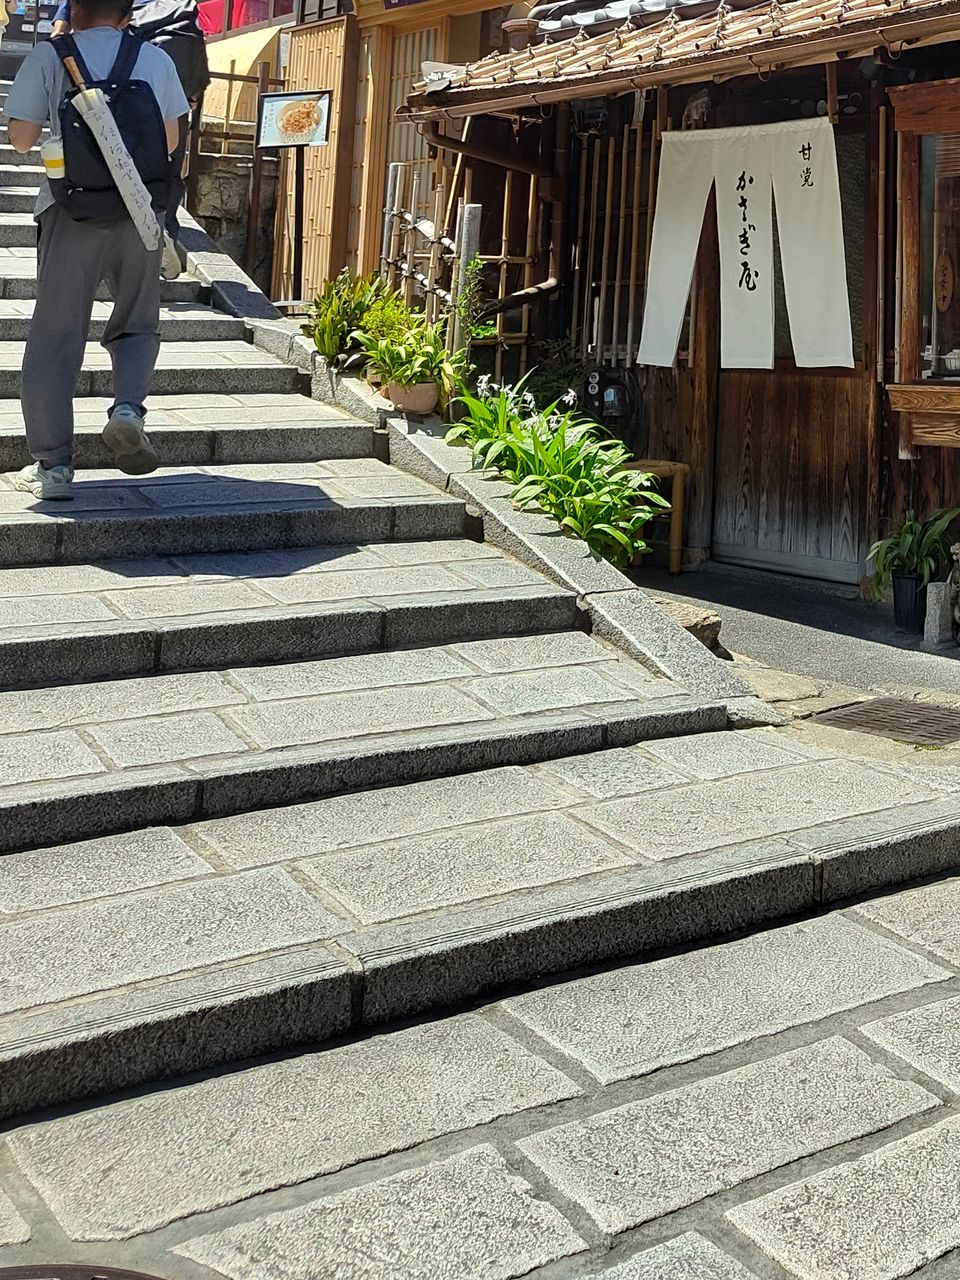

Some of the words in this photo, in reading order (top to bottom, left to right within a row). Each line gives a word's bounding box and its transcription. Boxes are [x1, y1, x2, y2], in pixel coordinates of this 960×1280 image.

[798, 142, 814, 188] 甘党
[736, 170, 760, 291] かさぎ屋
